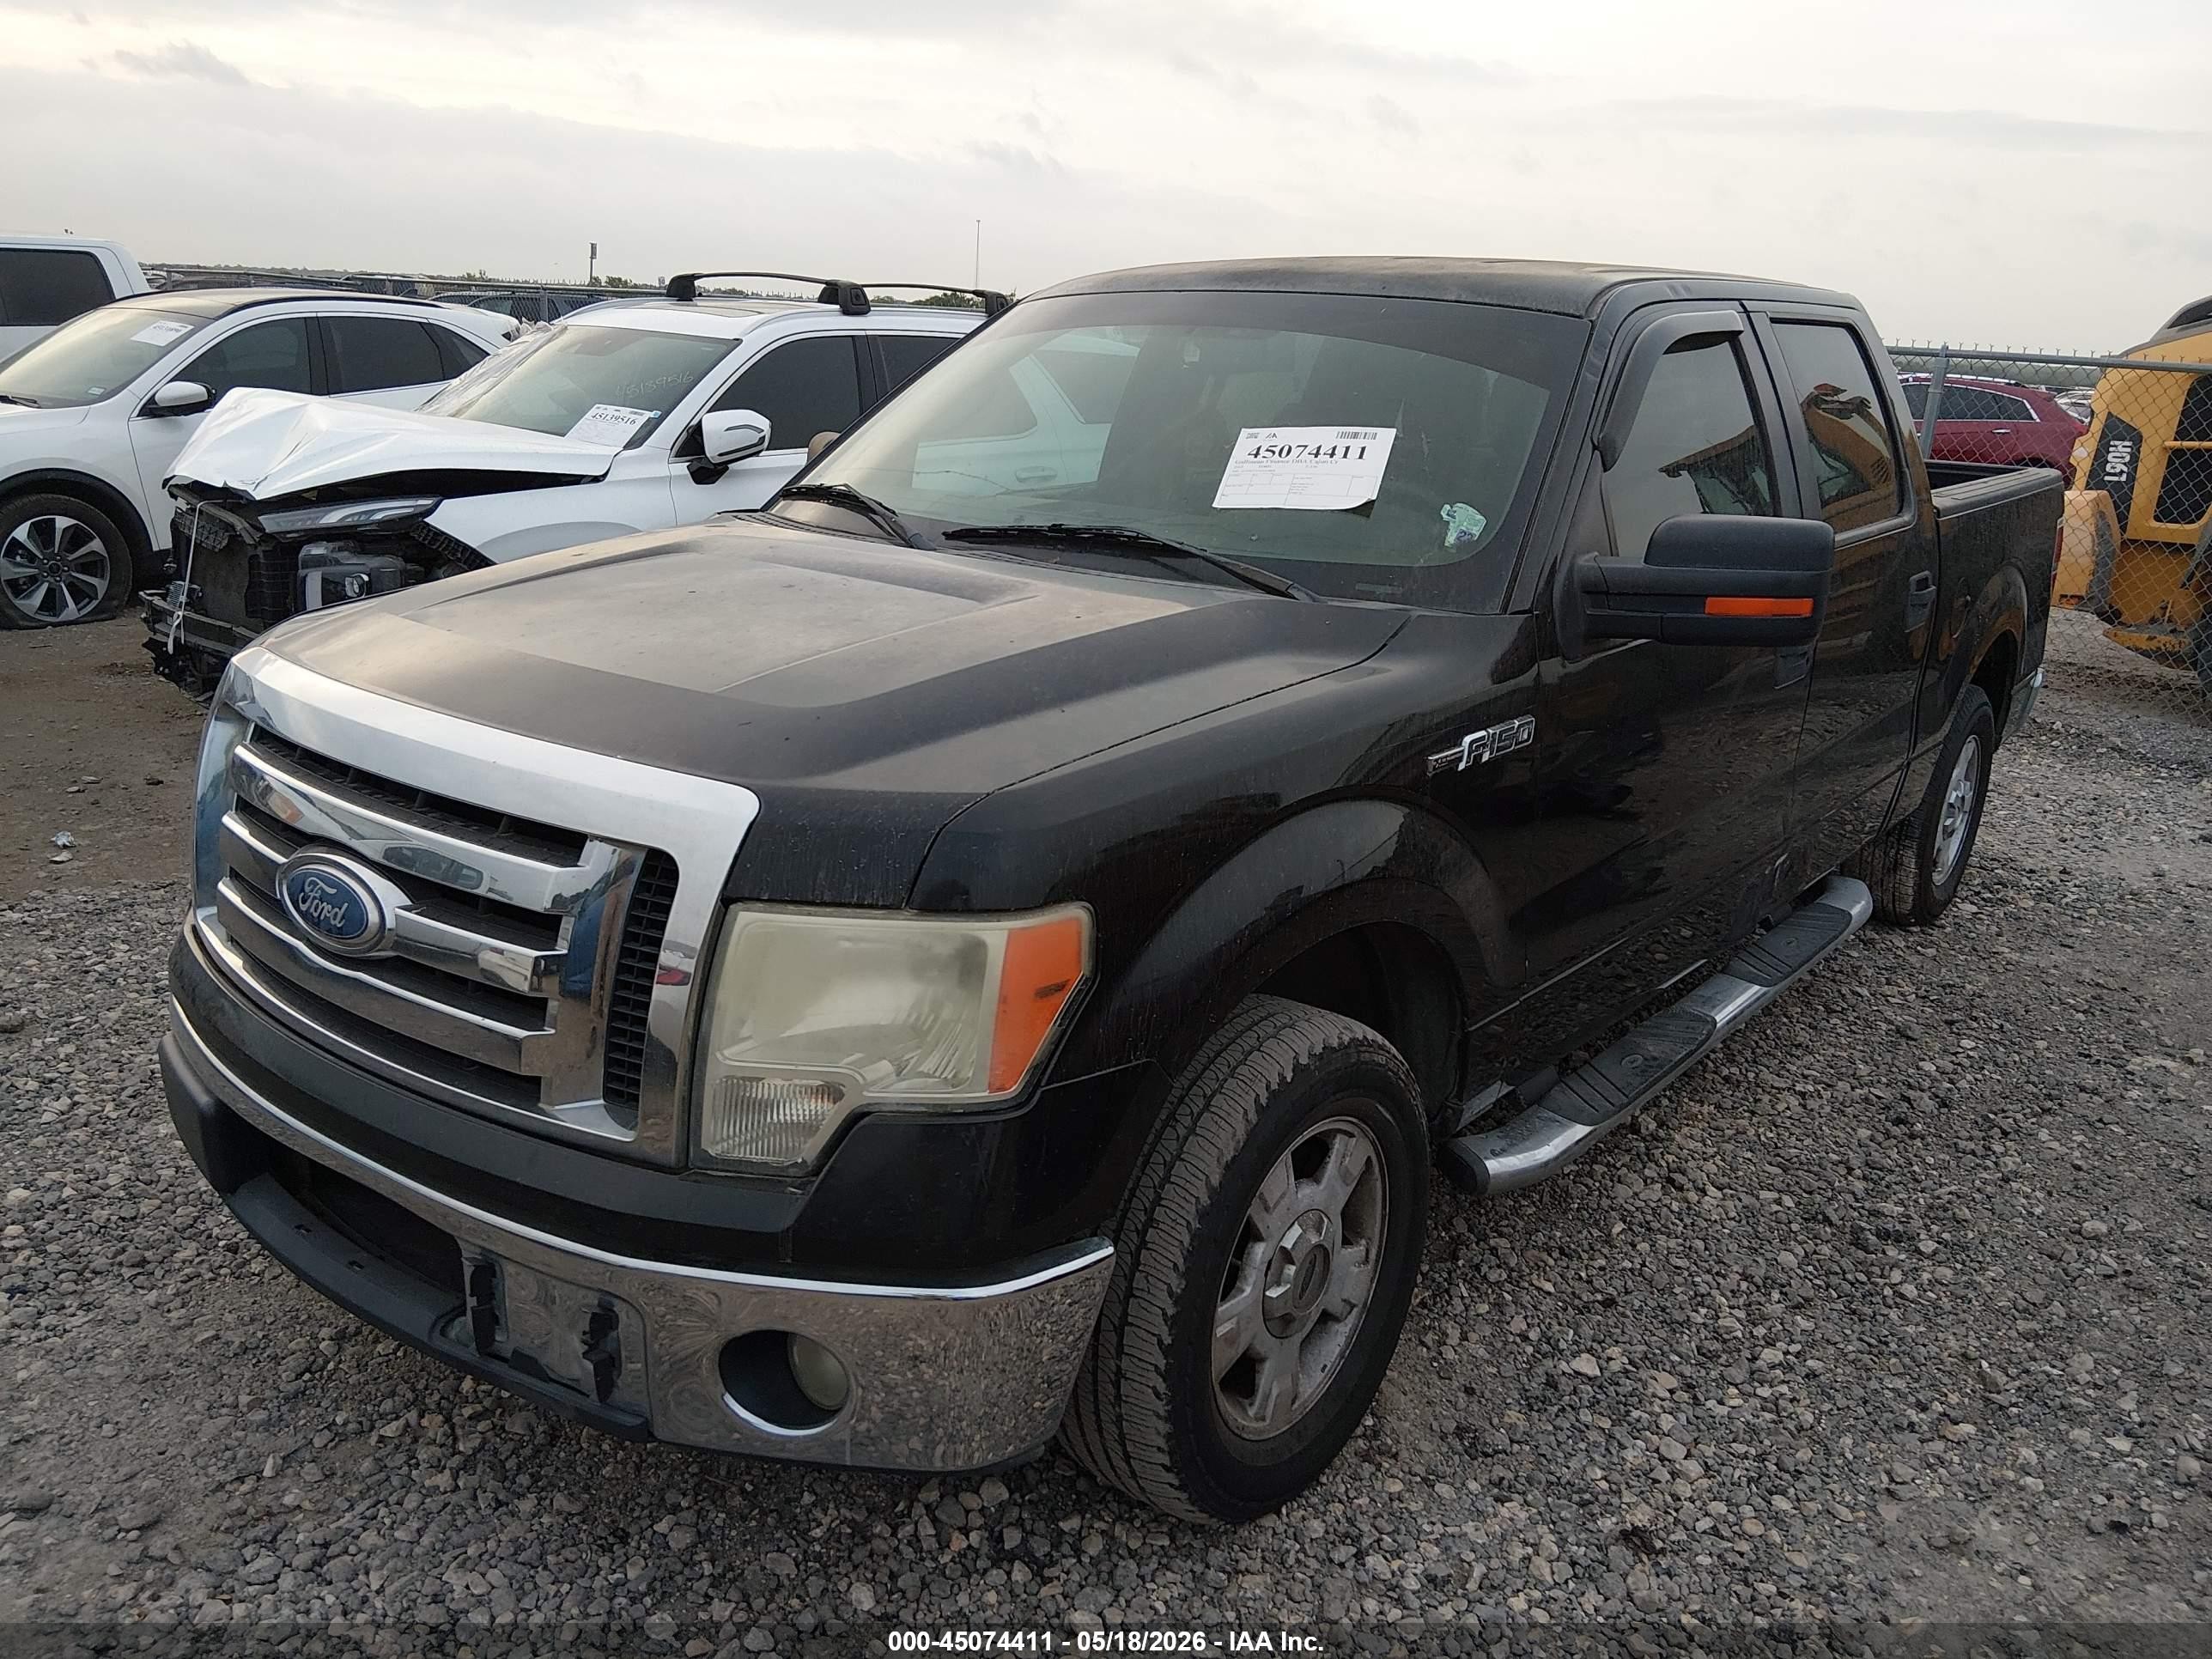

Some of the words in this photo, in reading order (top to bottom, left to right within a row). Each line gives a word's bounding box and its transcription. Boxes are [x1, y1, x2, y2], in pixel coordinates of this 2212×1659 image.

[591, 411, 637, 425] 45139516
[1248, 444, 1367, 460] 45074411
[2104, 441, 2133, 481] L90H
[298, 877, 349, 927] Ford
